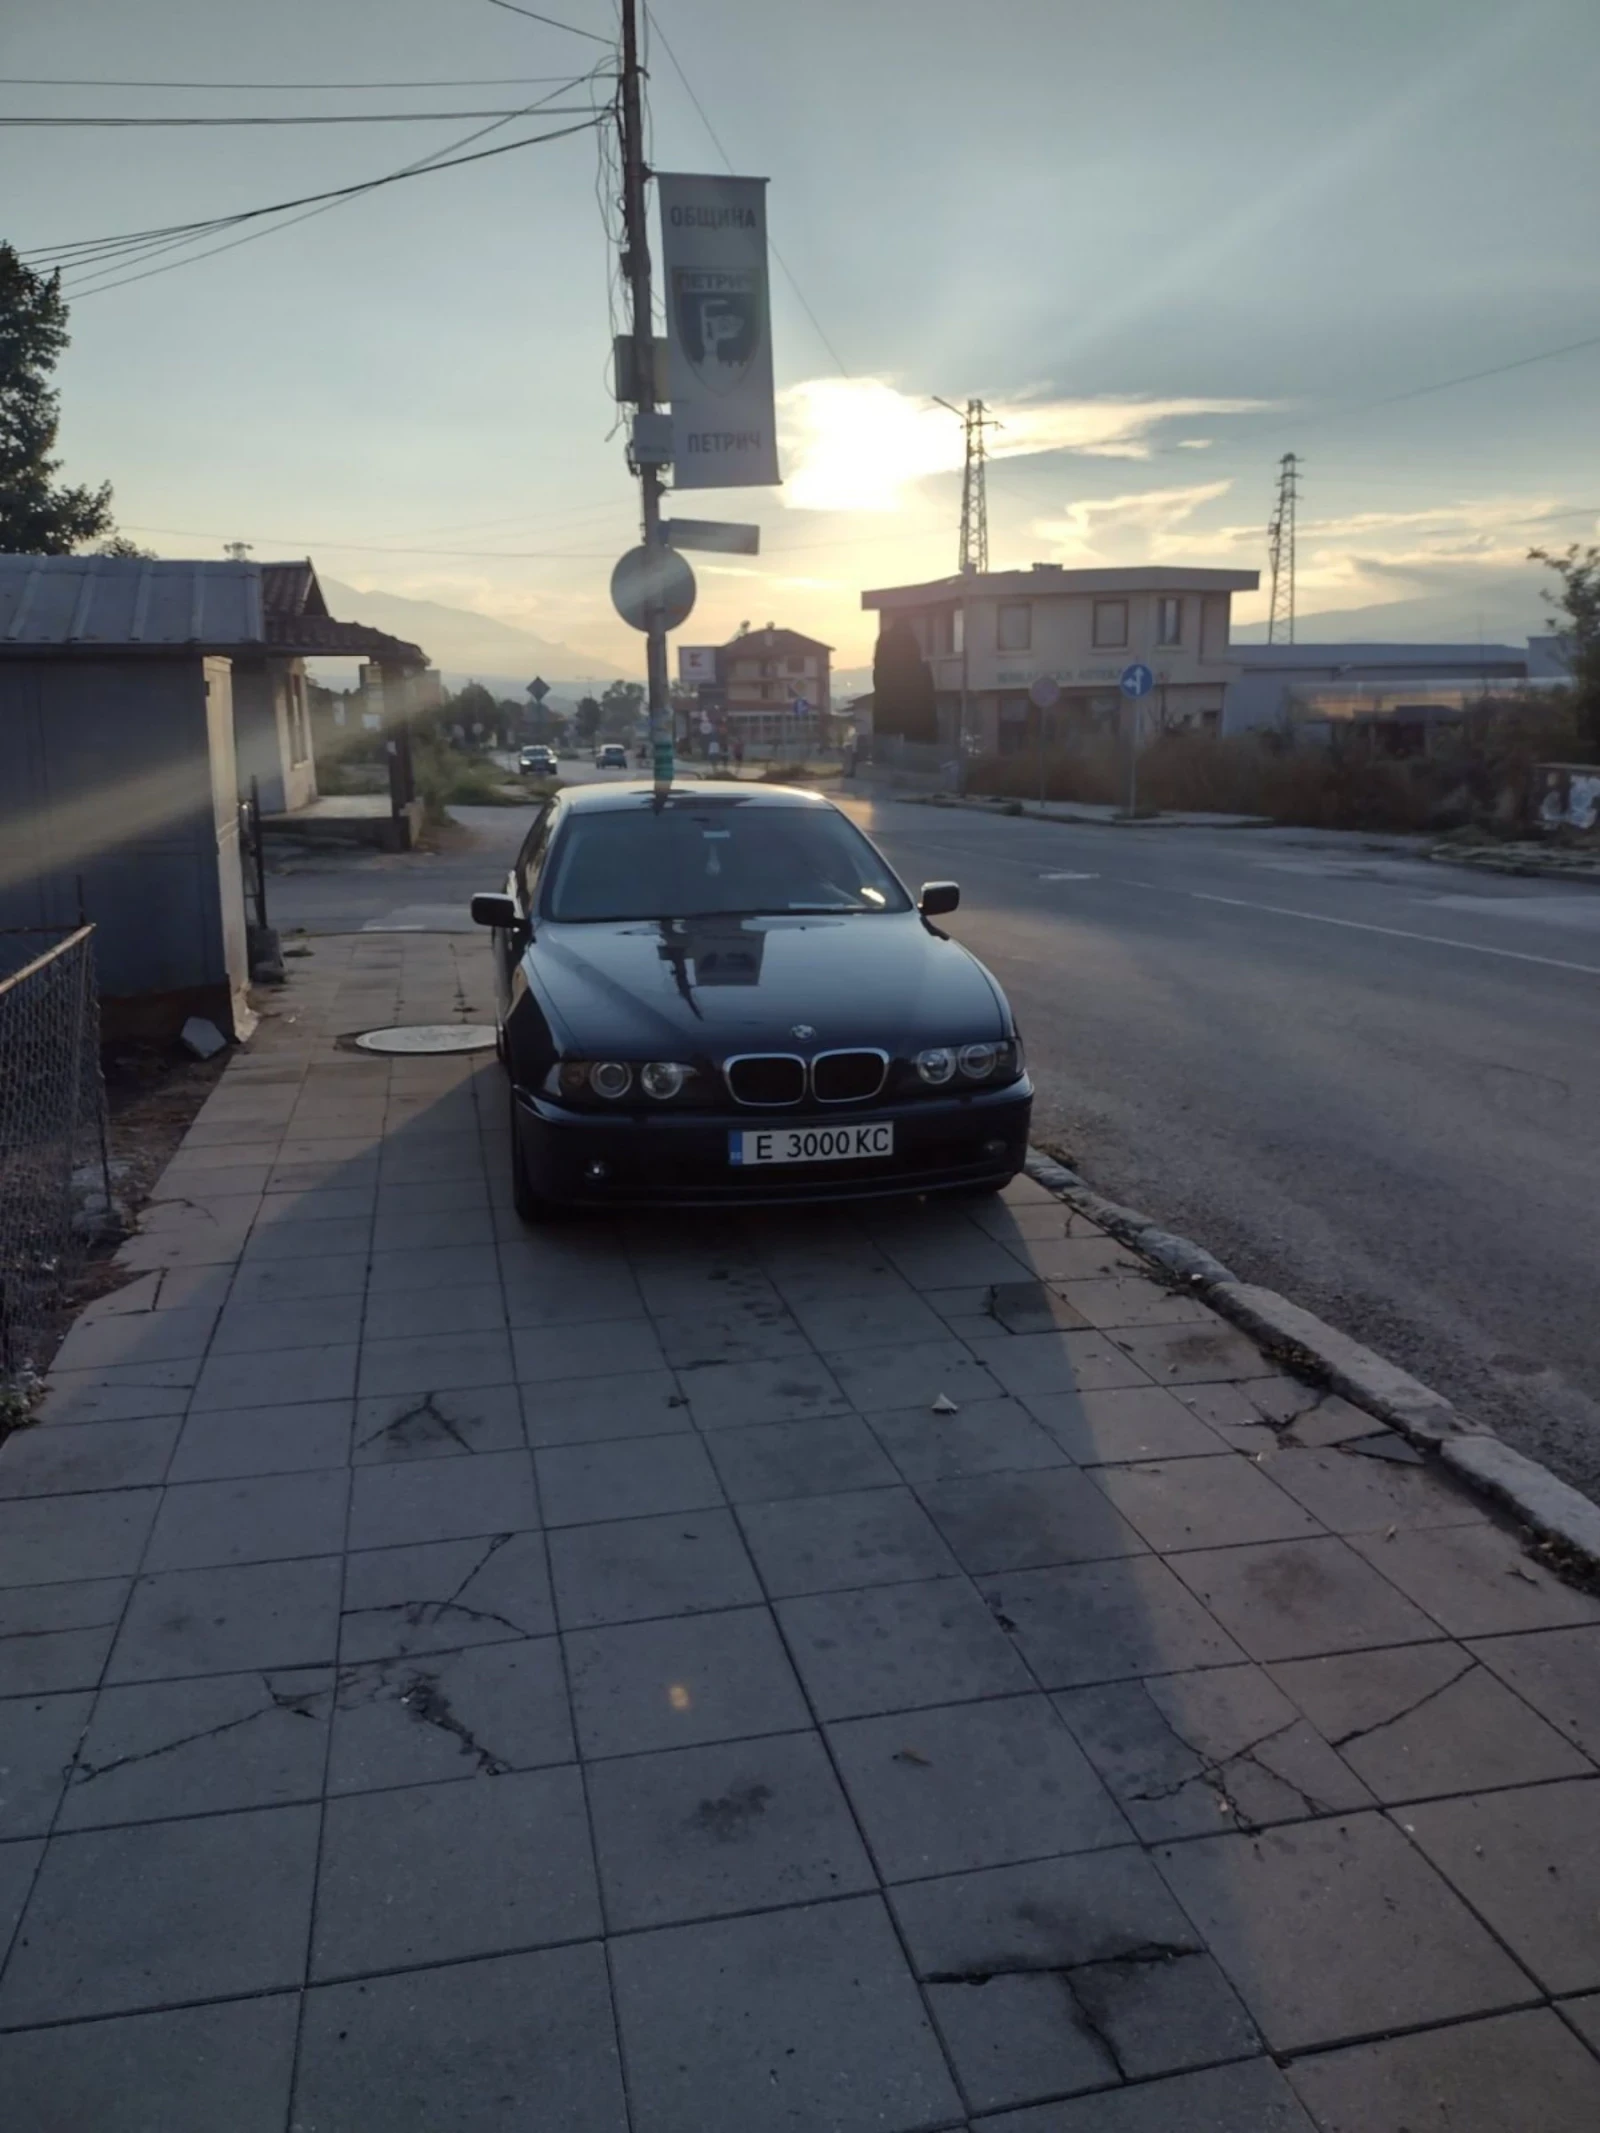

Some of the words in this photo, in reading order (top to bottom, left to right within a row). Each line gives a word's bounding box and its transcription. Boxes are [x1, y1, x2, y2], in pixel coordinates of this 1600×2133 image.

[670, 205, 757, 231] ОБЩИНА
[687, 430, 762, 453] ПЕТРИЧ
[756, 1134, 773, 1160] E
